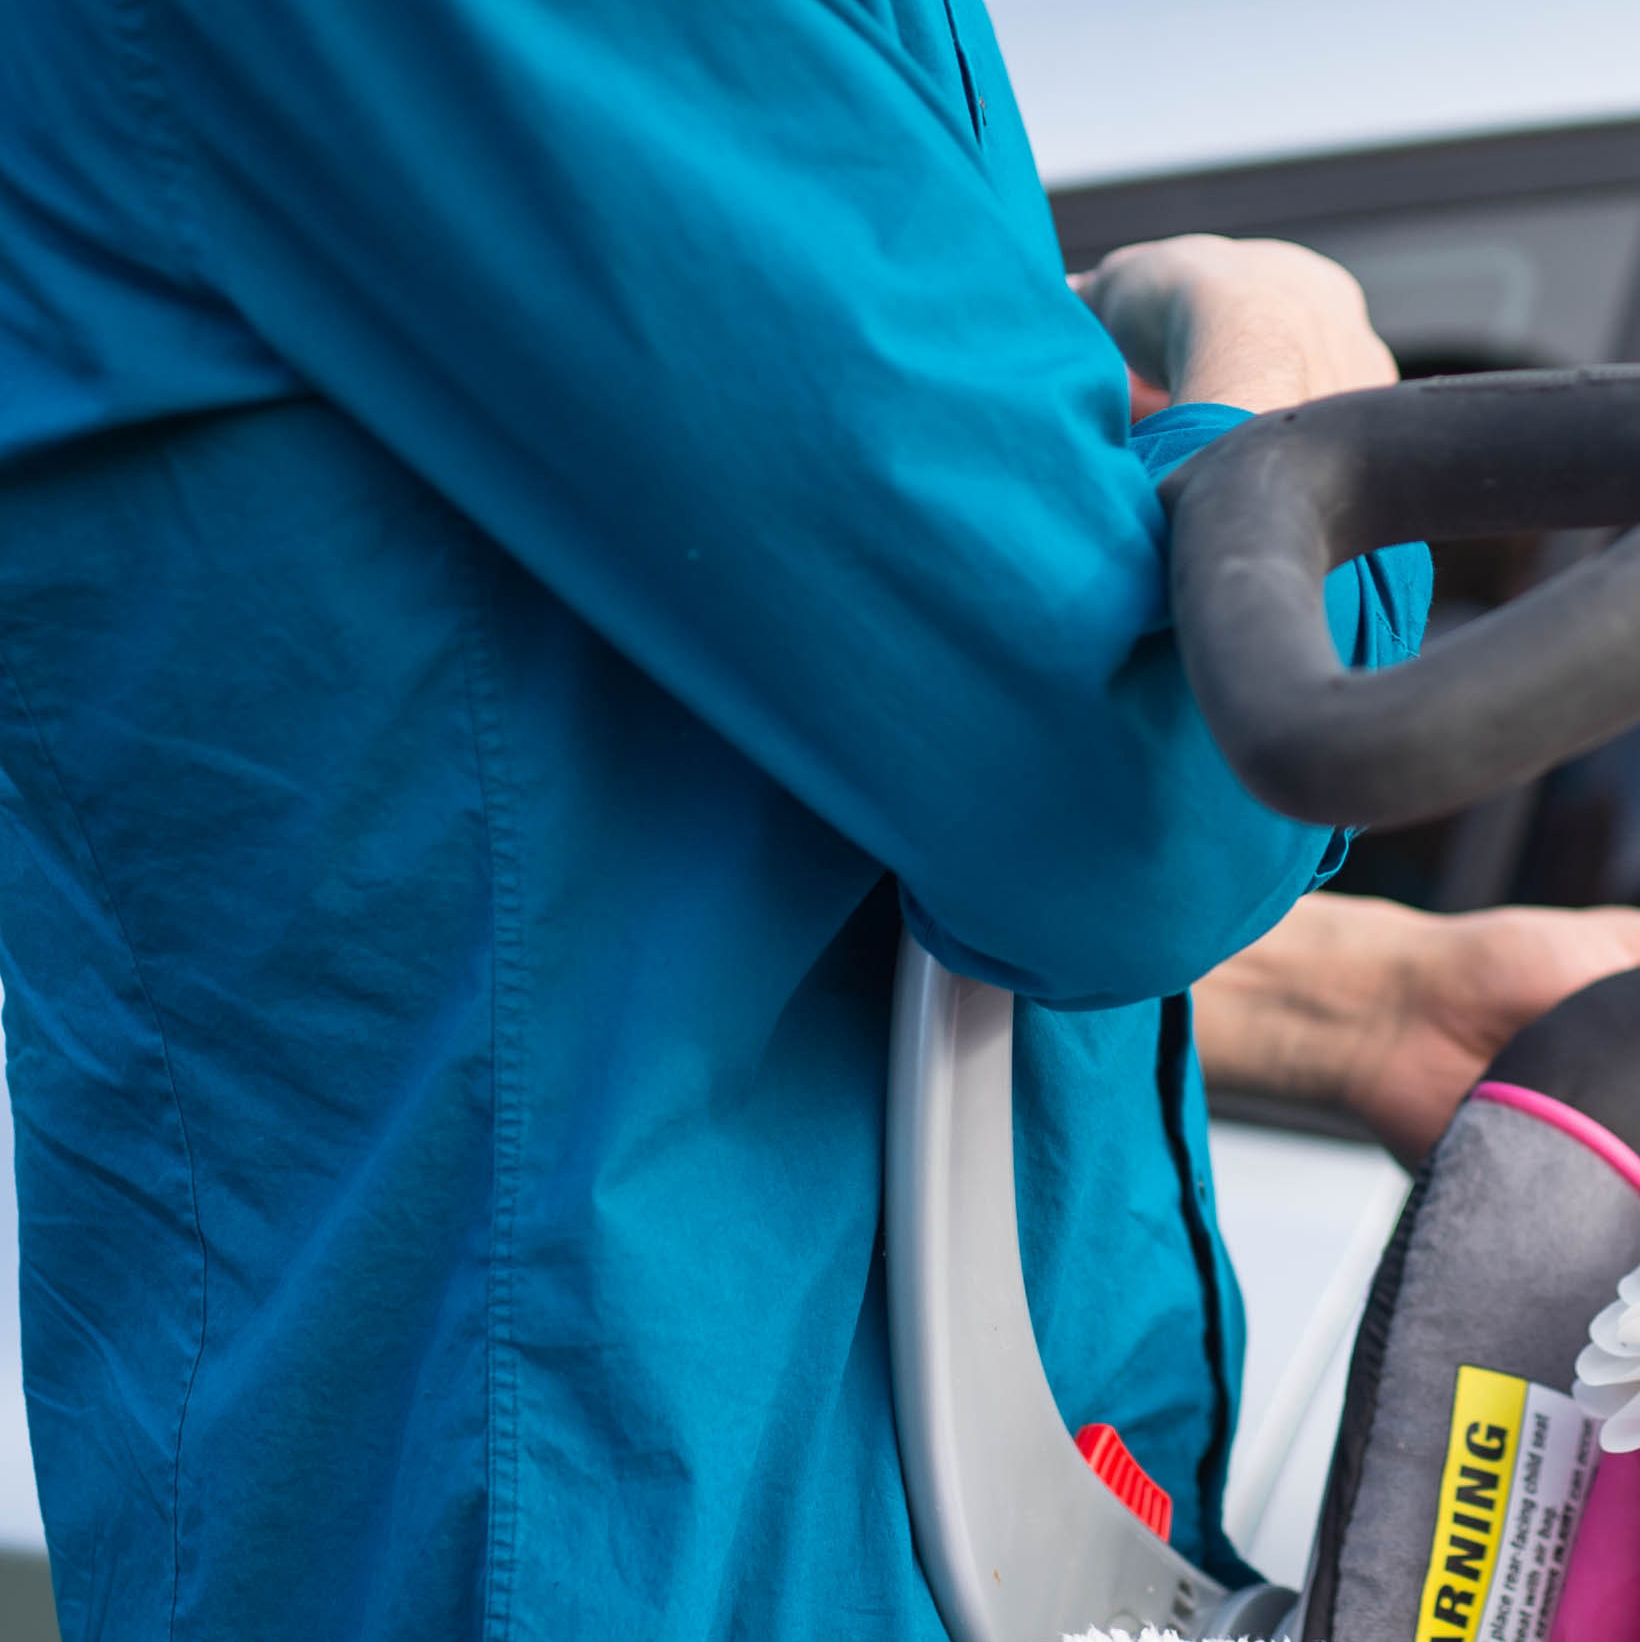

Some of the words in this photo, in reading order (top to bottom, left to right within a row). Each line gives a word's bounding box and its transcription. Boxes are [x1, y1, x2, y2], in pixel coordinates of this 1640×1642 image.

[1490, 1595, 1512, 1642] place
[1503, 1498, 1537, 1592] rear-facing
[1523, 1451, 1542, 1494] child
[1533, 1412, 1549, 1450] seat
[1525, 1569, 1540, 1606] with
[1534, 1542, 1546, 1566] air
